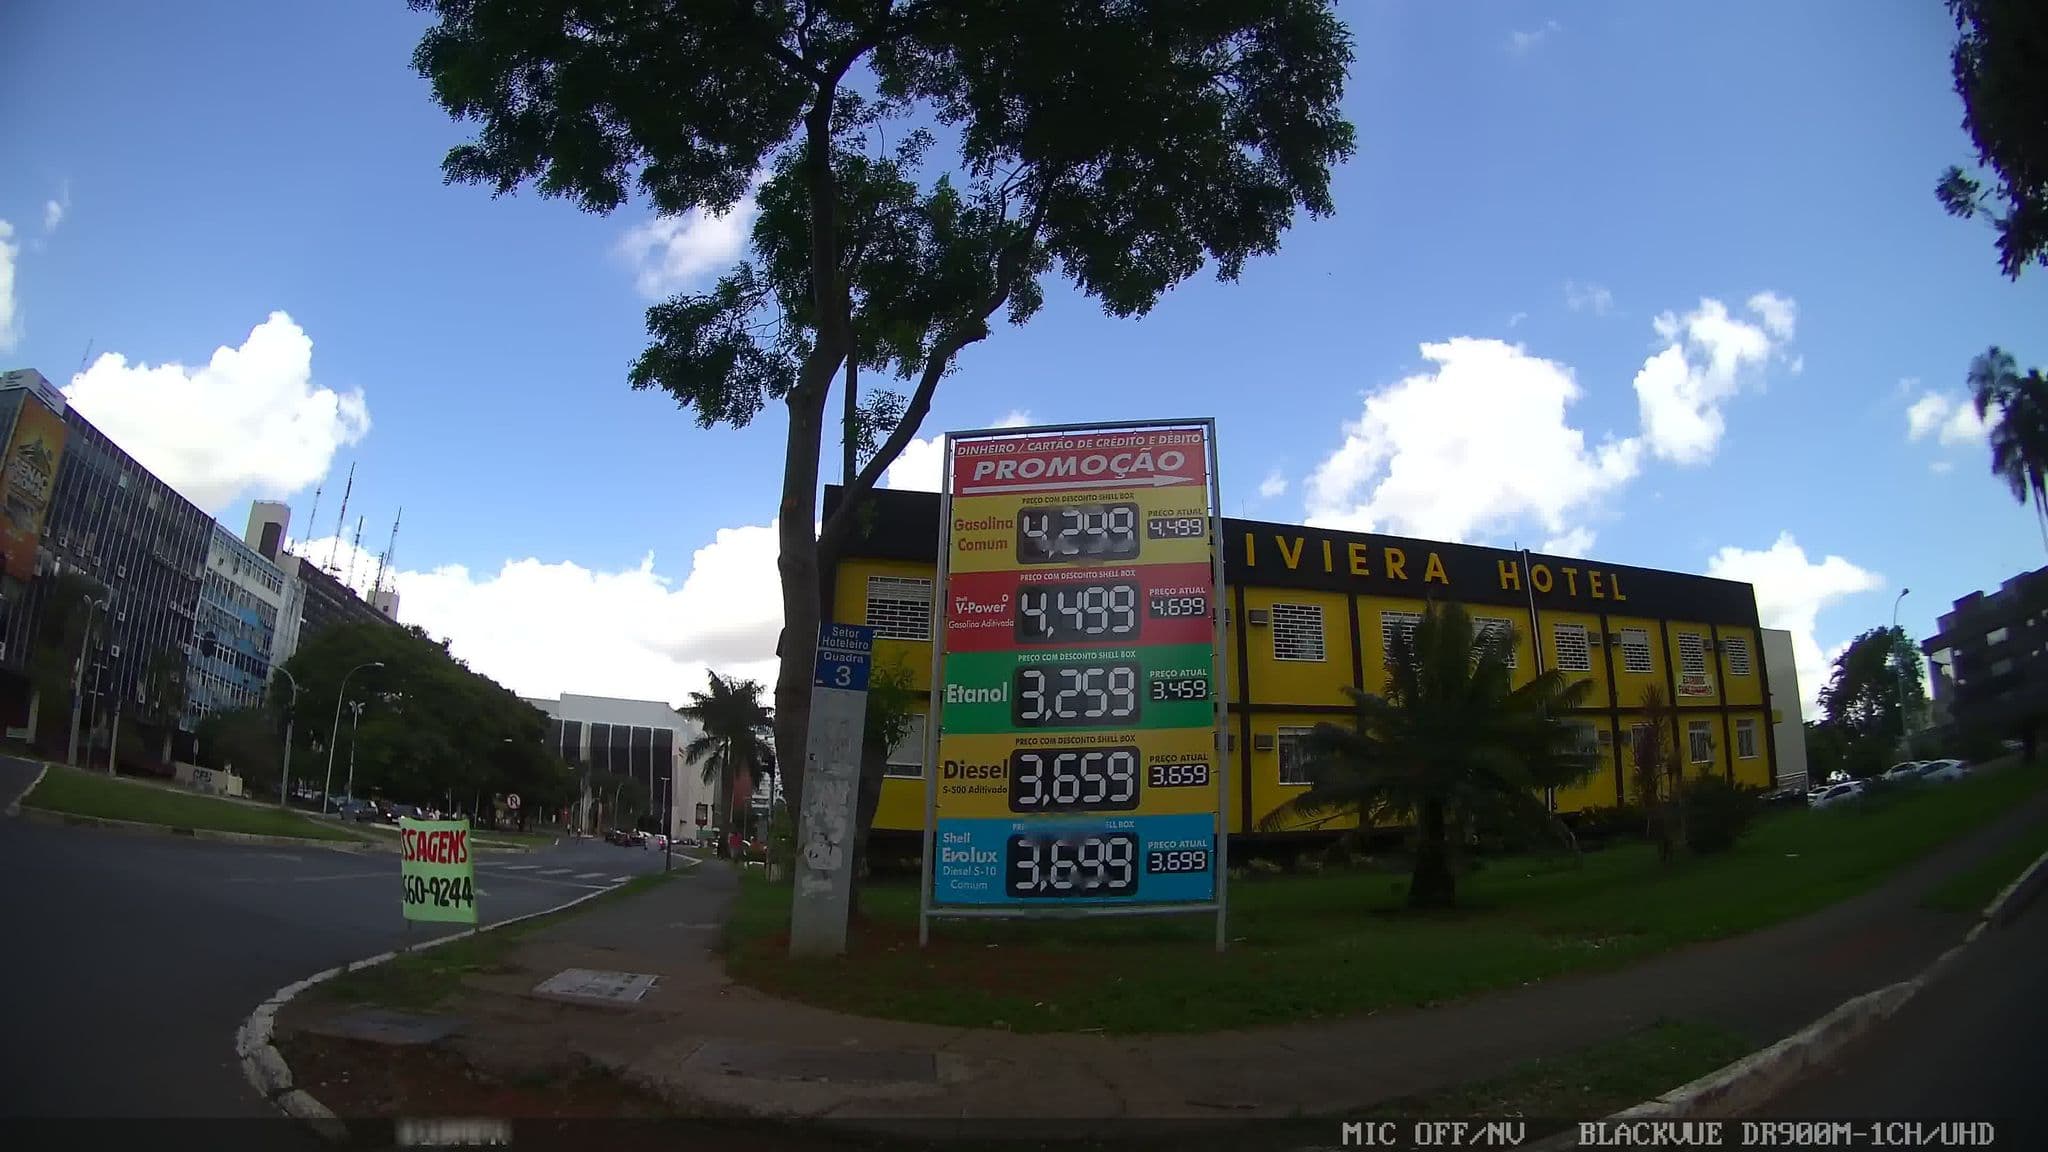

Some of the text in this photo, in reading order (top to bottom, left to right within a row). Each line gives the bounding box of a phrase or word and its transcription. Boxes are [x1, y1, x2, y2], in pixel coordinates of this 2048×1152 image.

[957, 443, 1015, 456] DINHEIRO
[1027, 437, 1074, 452] CARTÃO
[1077, 439, 1093, 449] DE
[1096, 435, 1146, 448] CRÉDITO
[1149, 436, 1156, 445] E
[1159, 433, 1201, 445] DÉBITO
[973, 447, 1185, 480] PROMOÇÃO
[1061, 494, 1098, 503] DESCONTO
[1099, 493, 1118, 501] SHELL
[1176, 508, 1203, 516] ATUAL
[954, 515, 1014, 532] Gasolina
[1150, 518, 1202, 537] 4,499
[958, 538, 1008, 552] Comum
[1245, 533, 1627, 601] IVIERA HOTEL
[1061, 571, 1098, 580] DESCONTO
[1099, 570, 1119, 578] SHELL
[1120, 569, 1136, 577] BOX
[1149, 586, 1206, 597] PREÇO ATUAL
[955, 602, 1007, 615] V-Power
[1021, 585, 1135, 638] 4,499
[1151, 597, 1205, 617] 4,699
[948, 618, 1015, 630] Gasolina Aditivada
[832, 626, 860, 639] Setor
[822, 635, 869, 650] Hoteleiro
[823, 651, 864, 664] Quadra
[1042, 653, 1059, 661] COM
[1060, 651, 1098, 660] DESCONTO
[1099, 650, 1119, 659] SHELL
[1120, 650, 1136, 658] BOX
[835, 665, 851, 686] 3
[1149, 668, 1208, 679] PREÇO ATUAL
[947, 681, 1008, 703] Etanol
[1021, 666, 1135, 722] 3,259
[1152, 679, 1206, 700] 3,459
[1039, 737, 1057, 745] COM
[1057, 736, 1096, 744] DESCONTO
[1097, 735, 1118, 743] SHELL
[1120, 734, 1136, 742] BOX
[1149, 753, 1208, 763] PREÇO ATUAL
[943, 758, 1008, 780] Diesel
[1152, 764, 1207, 786] 3,659
[1018, 751, 1134, 807] 3,659
[942, 784, 1008, 795] S-500 Aditivado
[1119, 820, 1136, 828] BOX
[943, 832, 970, 843] Shell
[1178, 839, 1208, 848] ATUAL
[942, 846, 998, 863] Evolux
[1151, 851, 1206, 871] 3,699
[943, 865, 997, 876] Diesel S-10
[1016, 837, 1133, 892] 3,699
[950, 879, 988, 889] Comum
